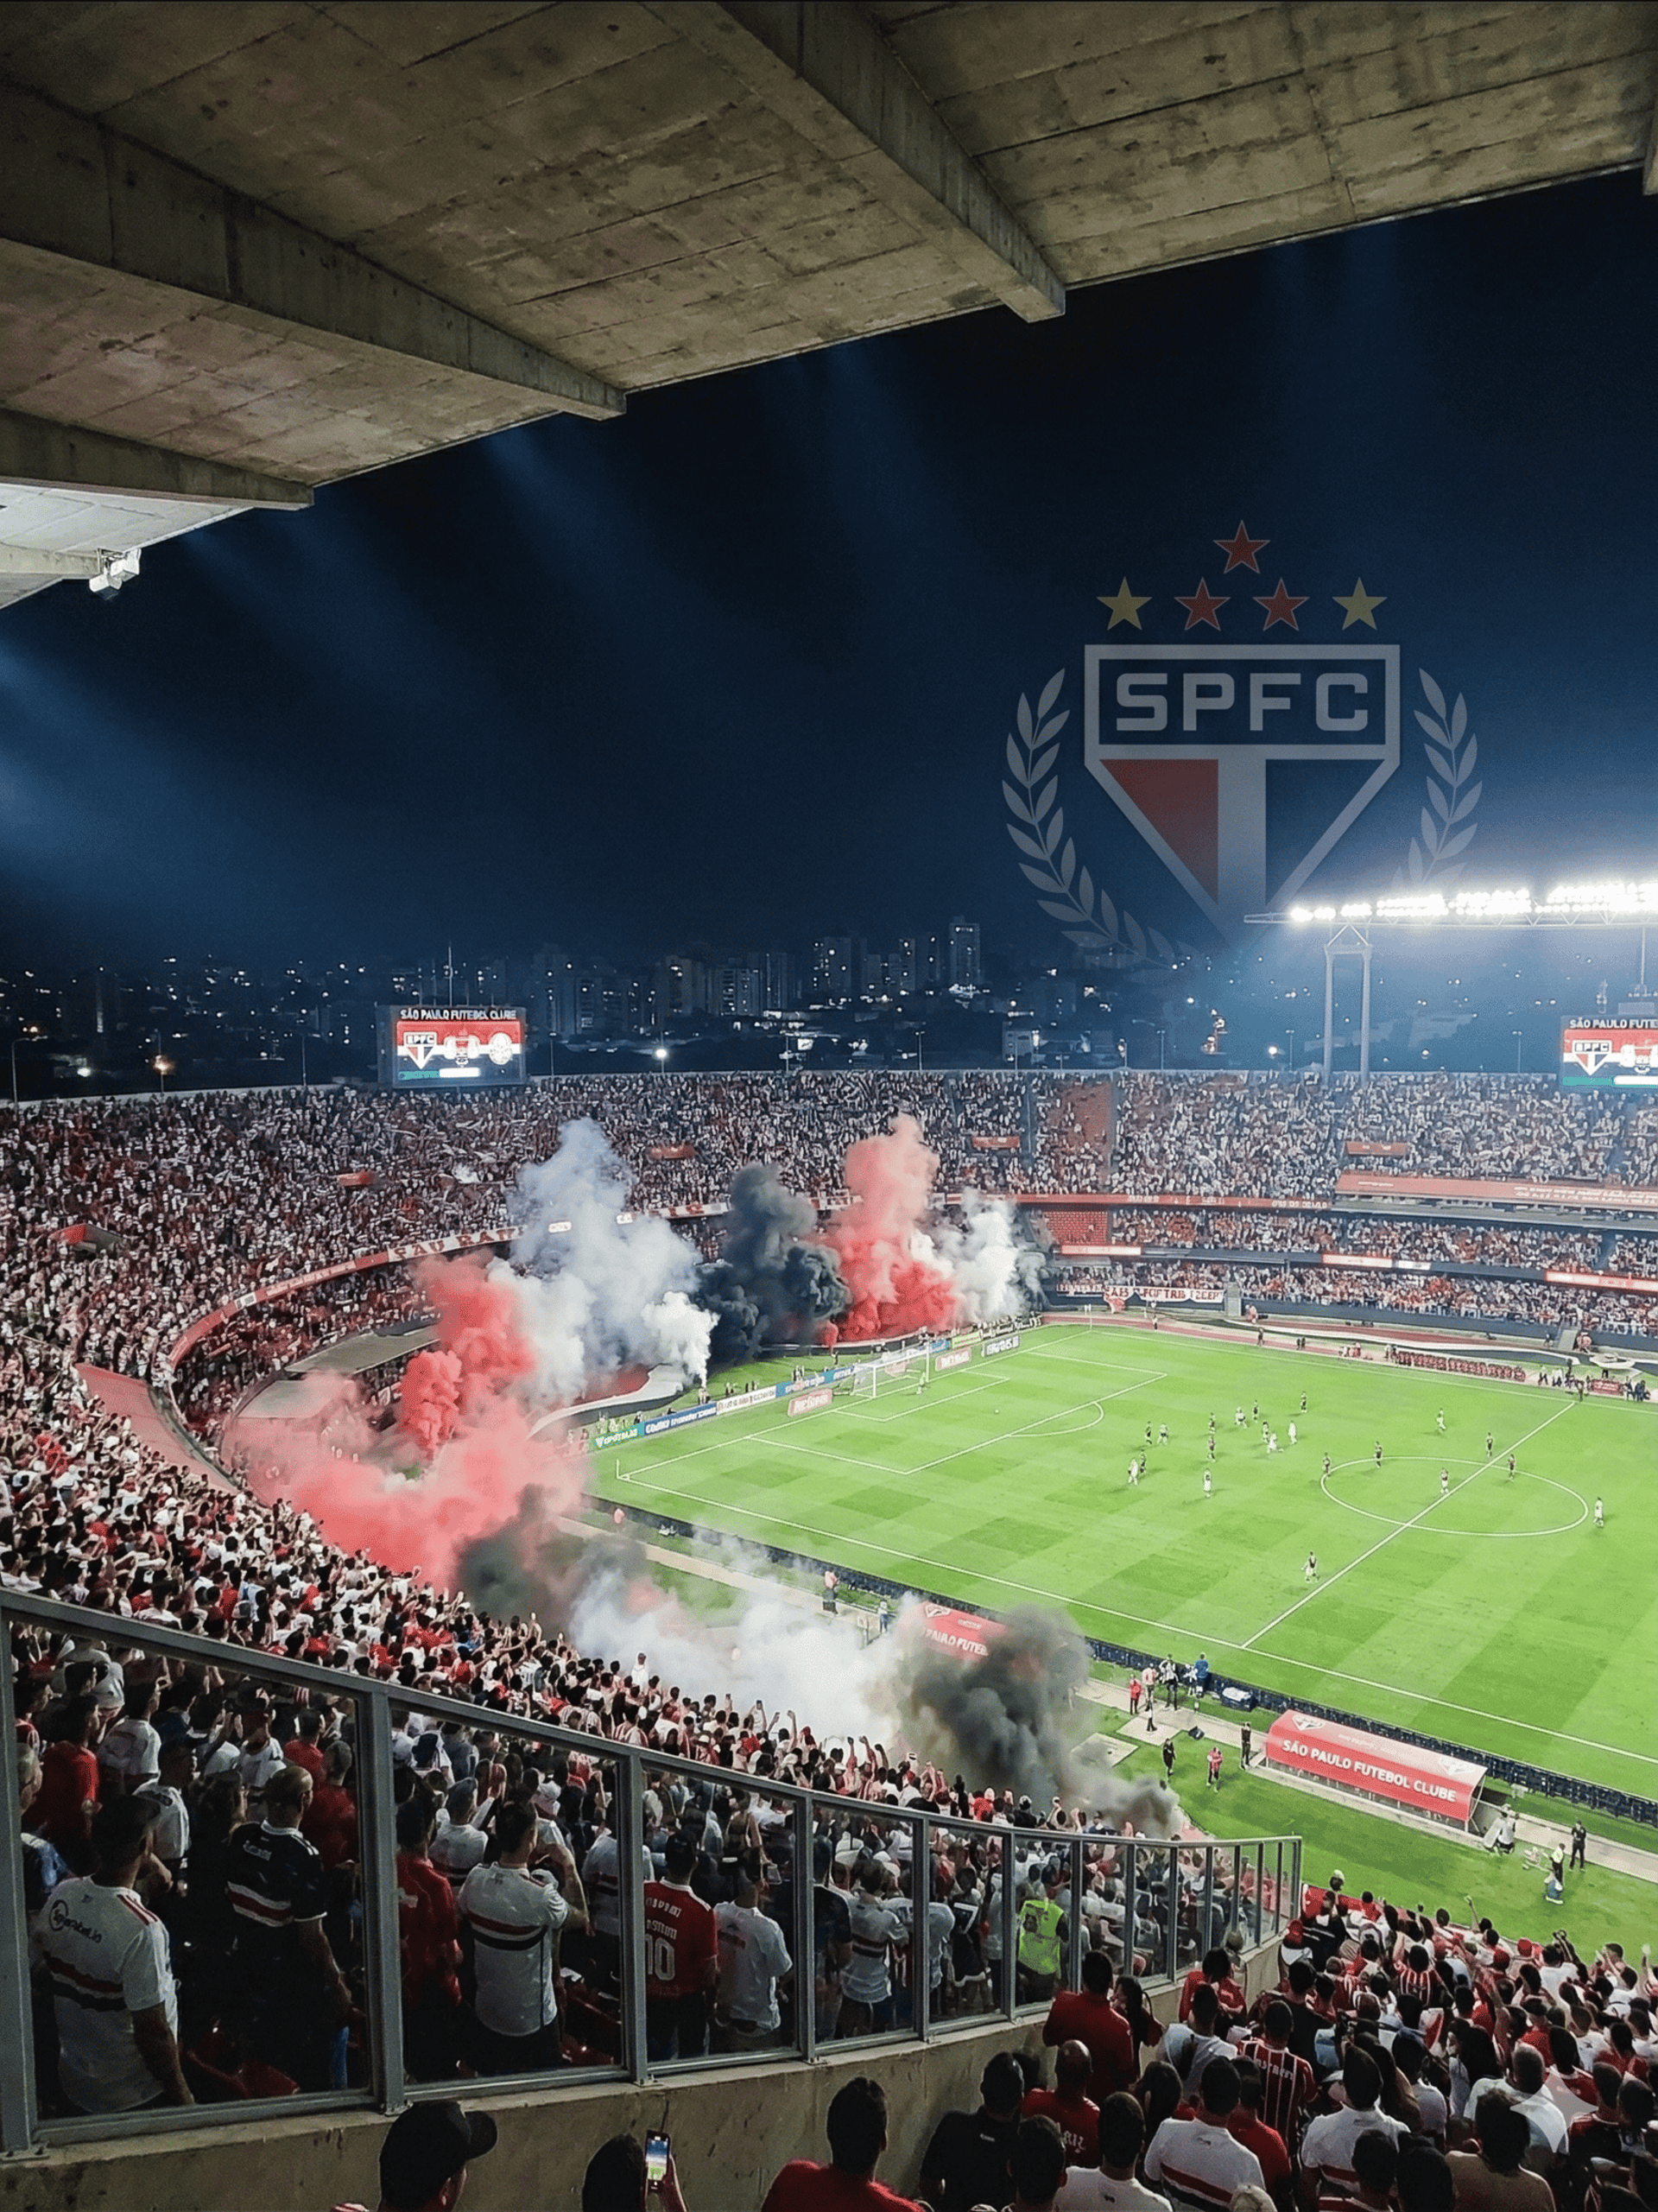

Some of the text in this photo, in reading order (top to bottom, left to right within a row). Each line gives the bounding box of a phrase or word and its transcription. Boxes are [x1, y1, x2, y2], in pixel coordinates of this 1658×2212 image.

[1281, 1739, 1457, 1803] SÃO PAULO FUTEBOL CLUBE
[953, 1902, 979, 1934] 7
